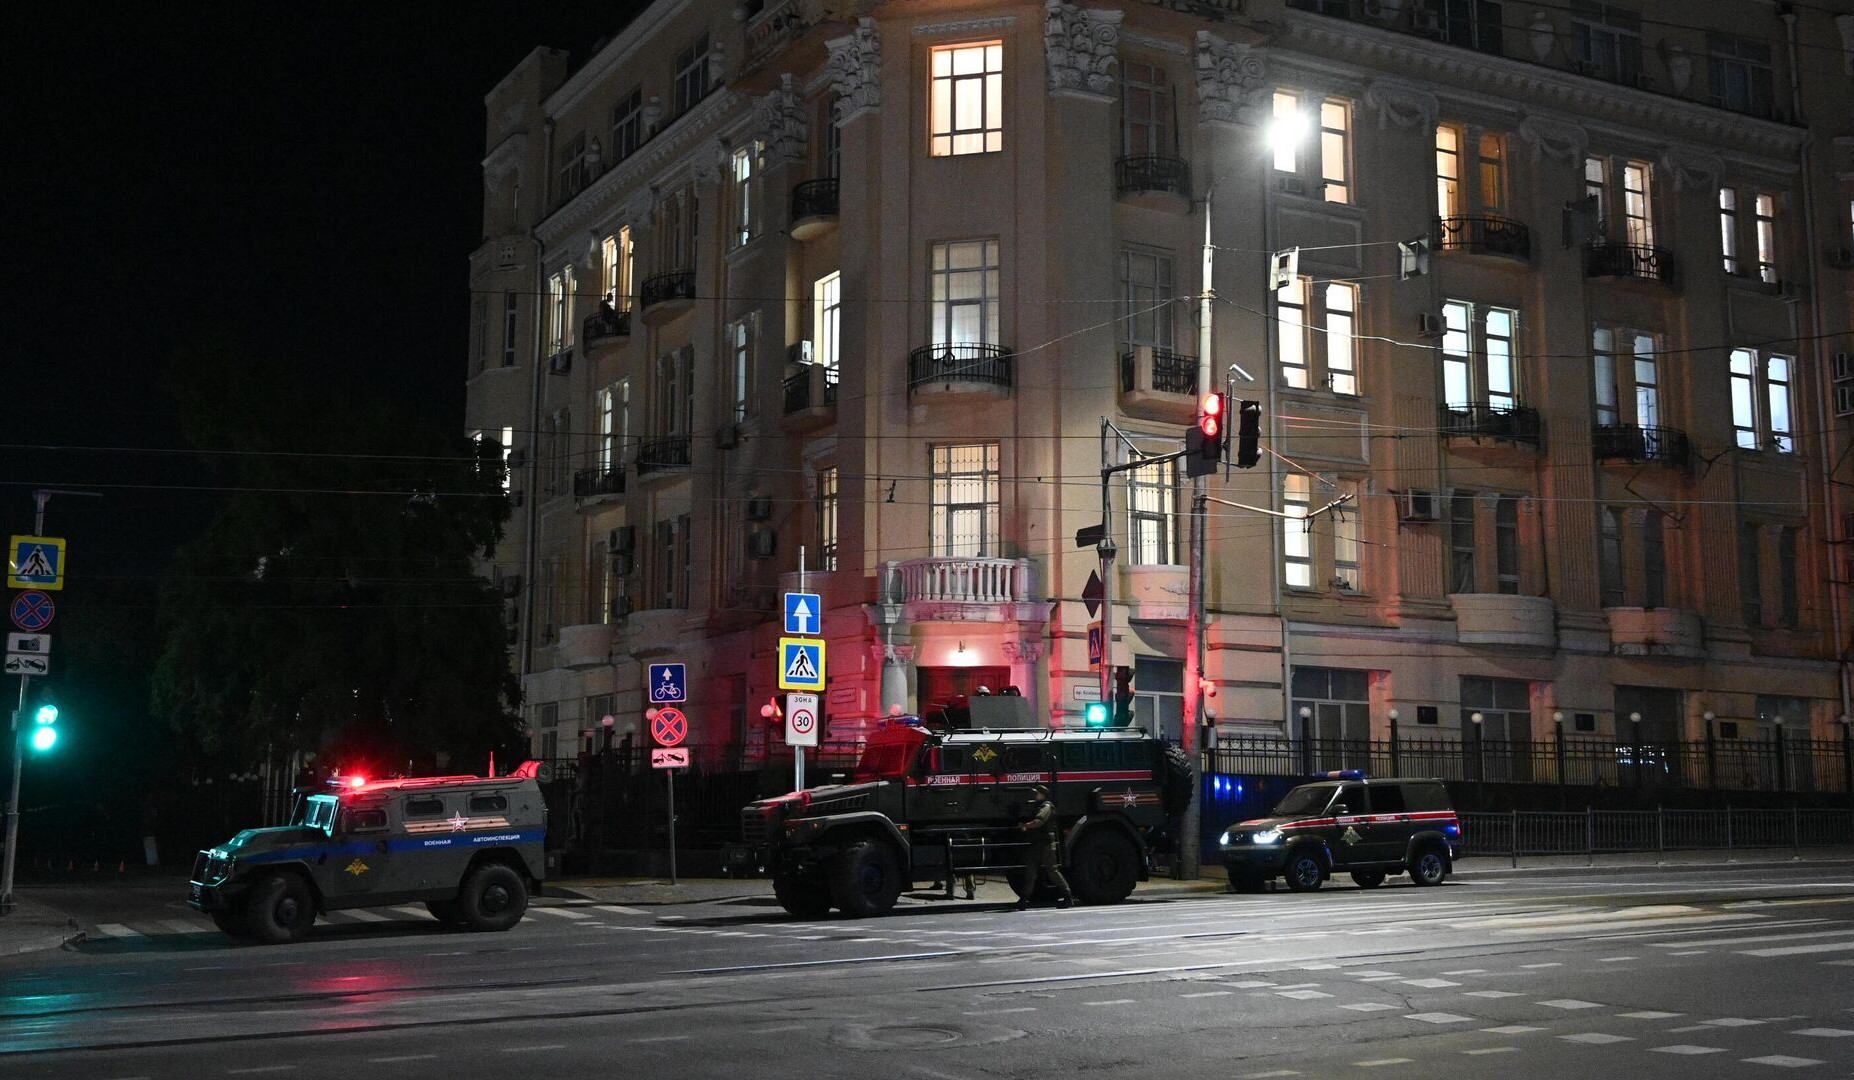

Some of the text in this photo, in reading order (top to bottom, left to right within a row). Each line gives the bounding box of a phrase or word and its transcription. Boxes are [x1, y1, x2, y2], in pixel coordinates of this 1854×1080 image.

[797, 716, 810, 727] 30
[1007, 774, 1041, 782] ПОЛИЦИЯ
[472, 834, 520, 842] АВТОИНСПЕКЦИЯ
